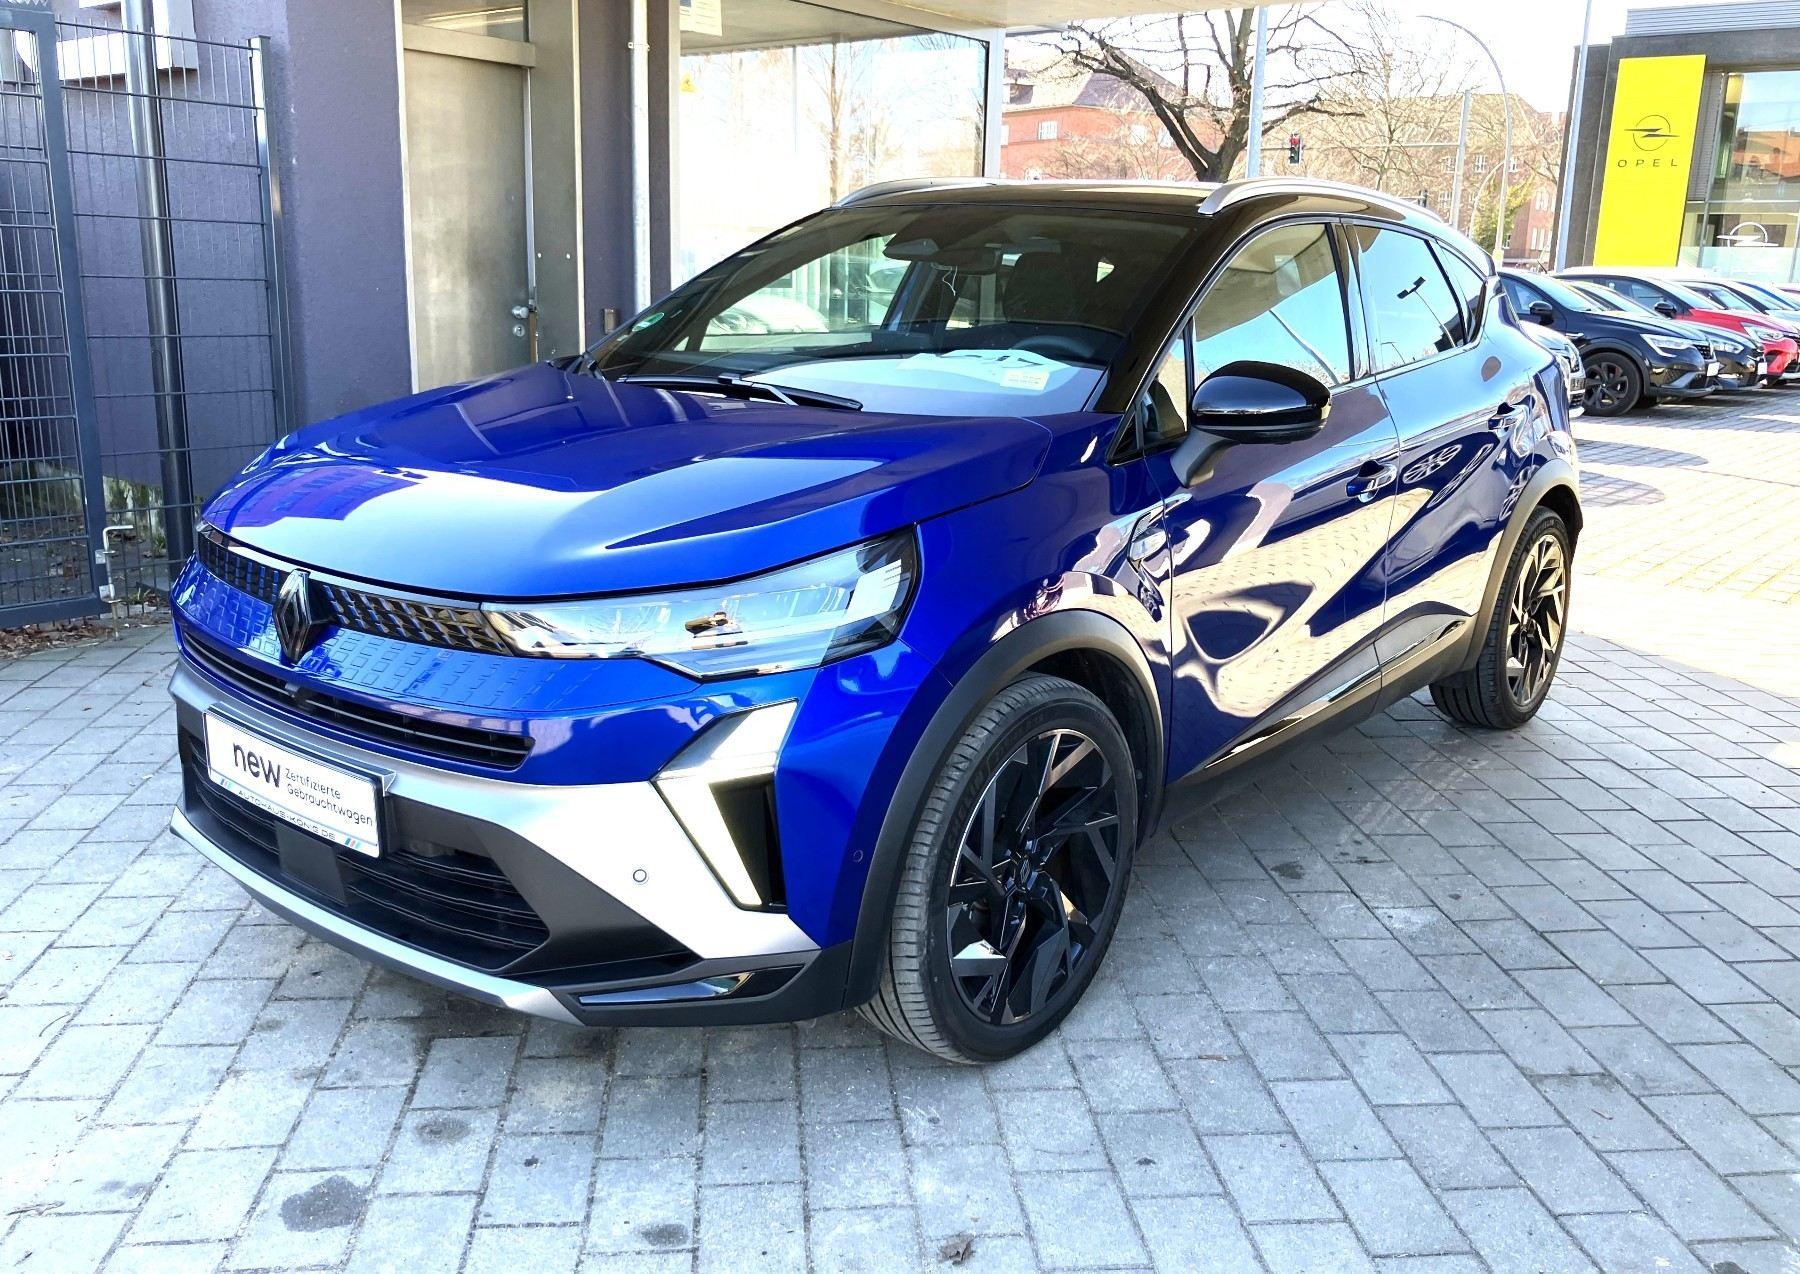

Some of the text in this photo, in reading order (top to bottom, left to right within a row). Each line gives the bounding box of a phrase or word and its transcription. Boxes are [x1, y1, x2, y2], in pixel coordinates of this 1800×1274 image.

[1617, 158, 1678, 168] OPEL
[233, 742, 280, 788] new
[286, 767, 341, 800] Zertifizierte
[287, 783, 373, 827] Gebrauchtwagen
